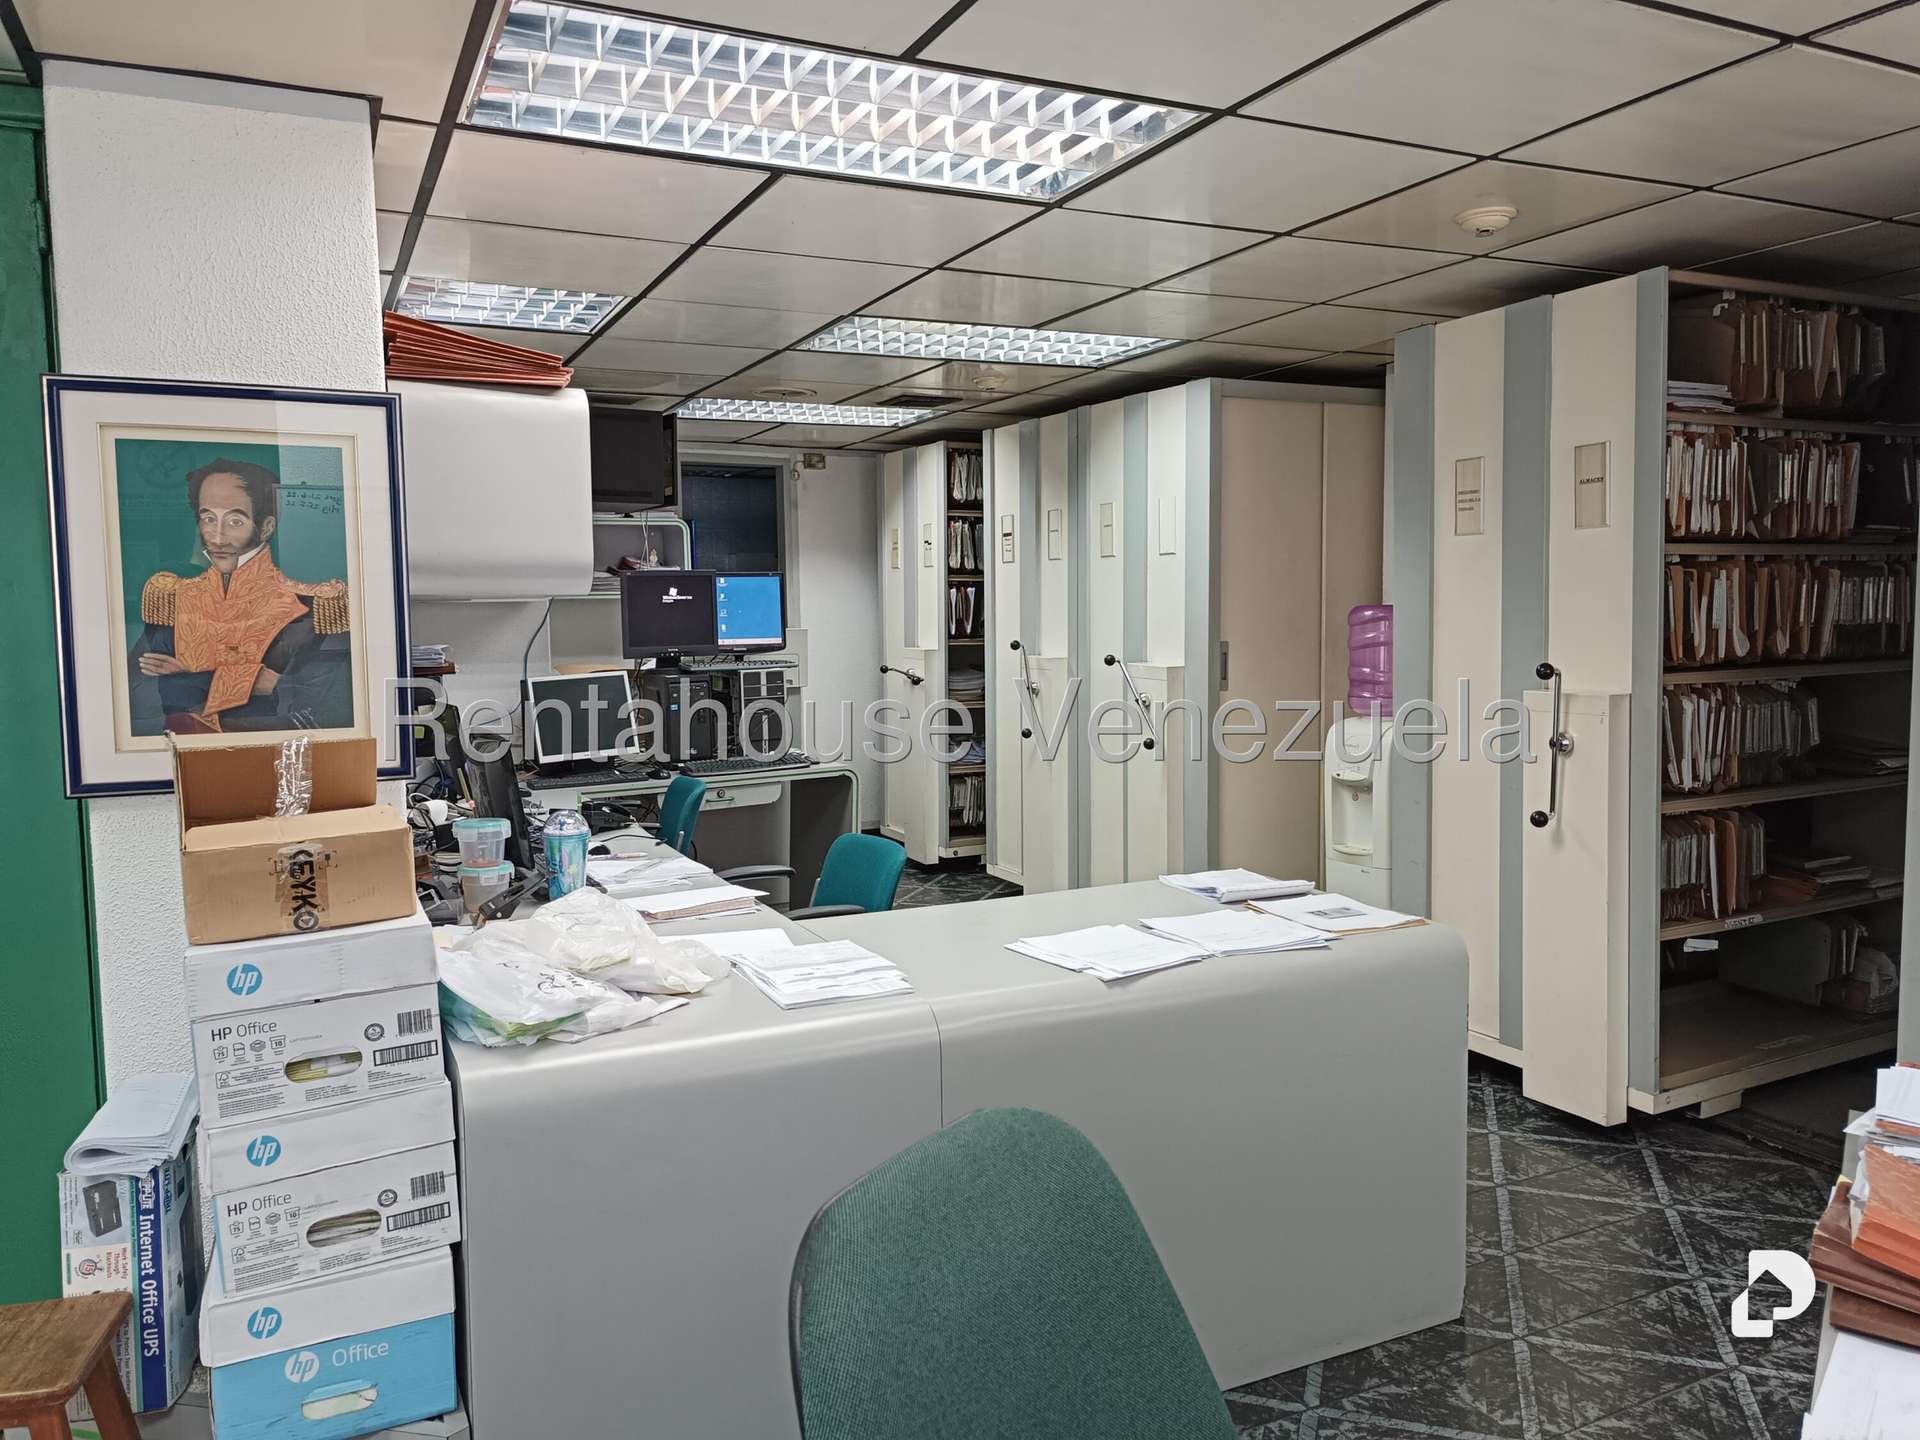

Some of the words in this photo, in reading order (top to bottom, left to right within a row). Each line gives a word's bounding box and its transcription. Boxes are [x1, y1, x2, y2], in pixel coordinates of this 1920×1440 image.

[228, 963, 262, 996] hp
[211, 1026, 232, 1042] HP
[236, 1021, 278, 1038] Office
[247, 1135, 281, 1167] hp
[227, 1201, 247, 1217] HP
[252, 1192, 292, 1211] Office
[140, 1214, 155, 1276] Internet
[142, 1280, 158, 1324] Office
[248, 1306, 282, 1340] hp
[144, 1328, 160, 1357] UPS
[284, 1350, 320, 1384] hp
[332, 1341, 389, 1367] Office
